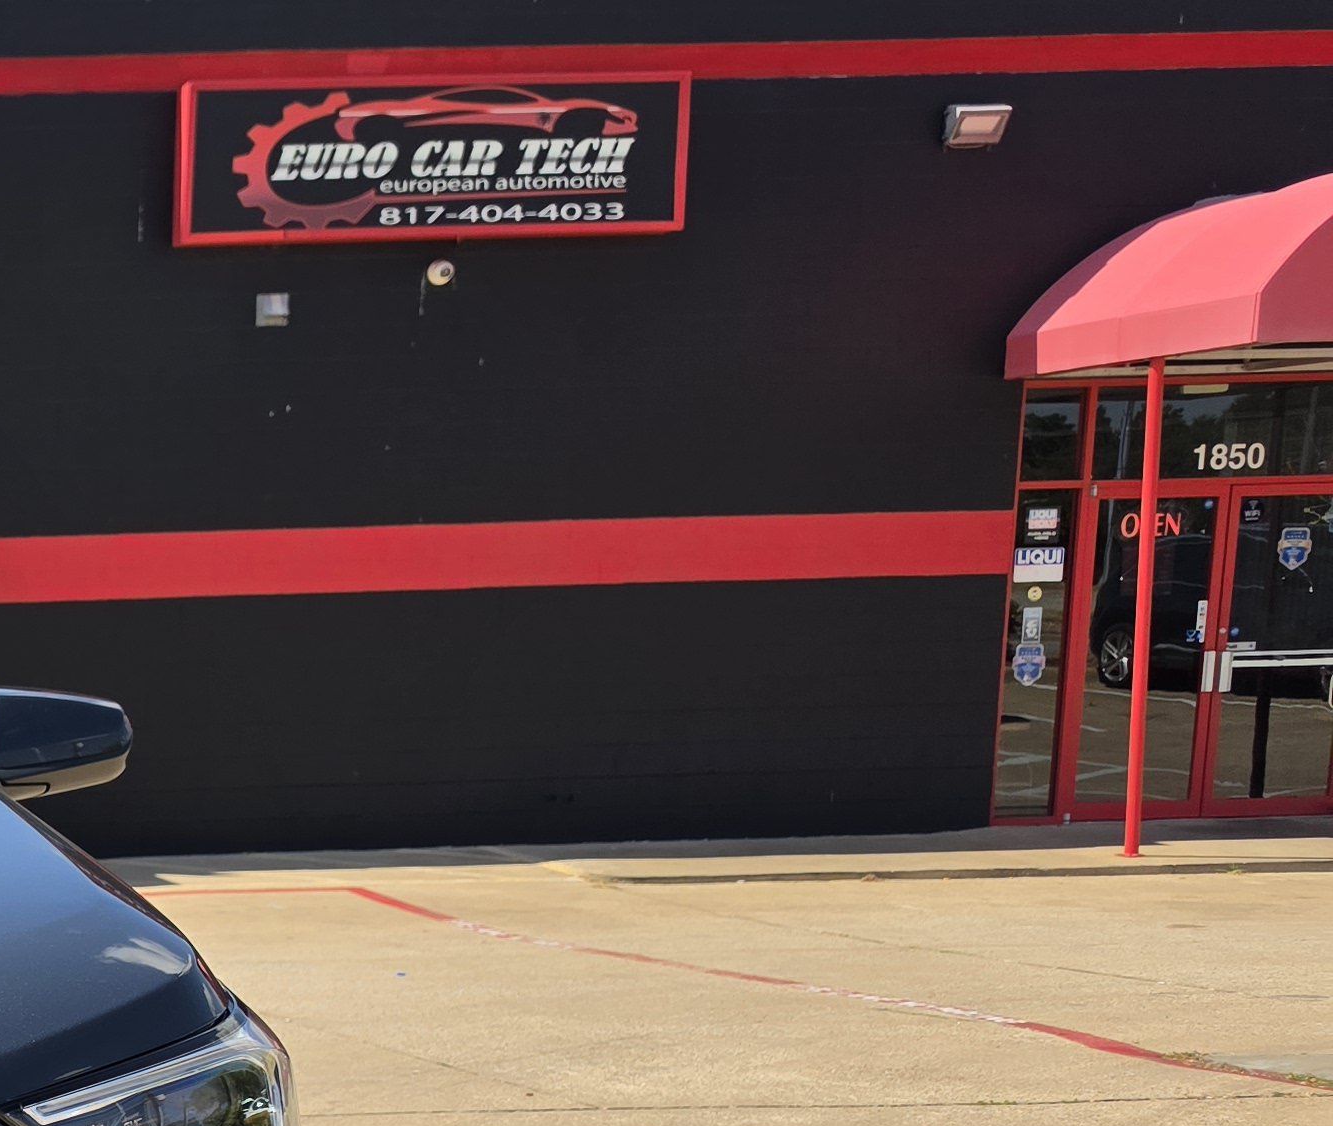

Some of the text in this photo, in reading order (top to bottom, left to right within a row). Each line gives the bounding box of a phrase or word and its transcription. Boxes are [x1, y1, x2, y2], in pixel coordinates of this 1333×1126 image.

[271, 136, 635, 182] EURO CAR TECH
[379, 171, 627, 195] european automotive
[379, 201, 624, 226] 817-404-4033
[1193, 442, 1265, 470] 1850
[1121, 513, 1181, 538] OEN
[1017, 549, 1063, 565] LIQUI
